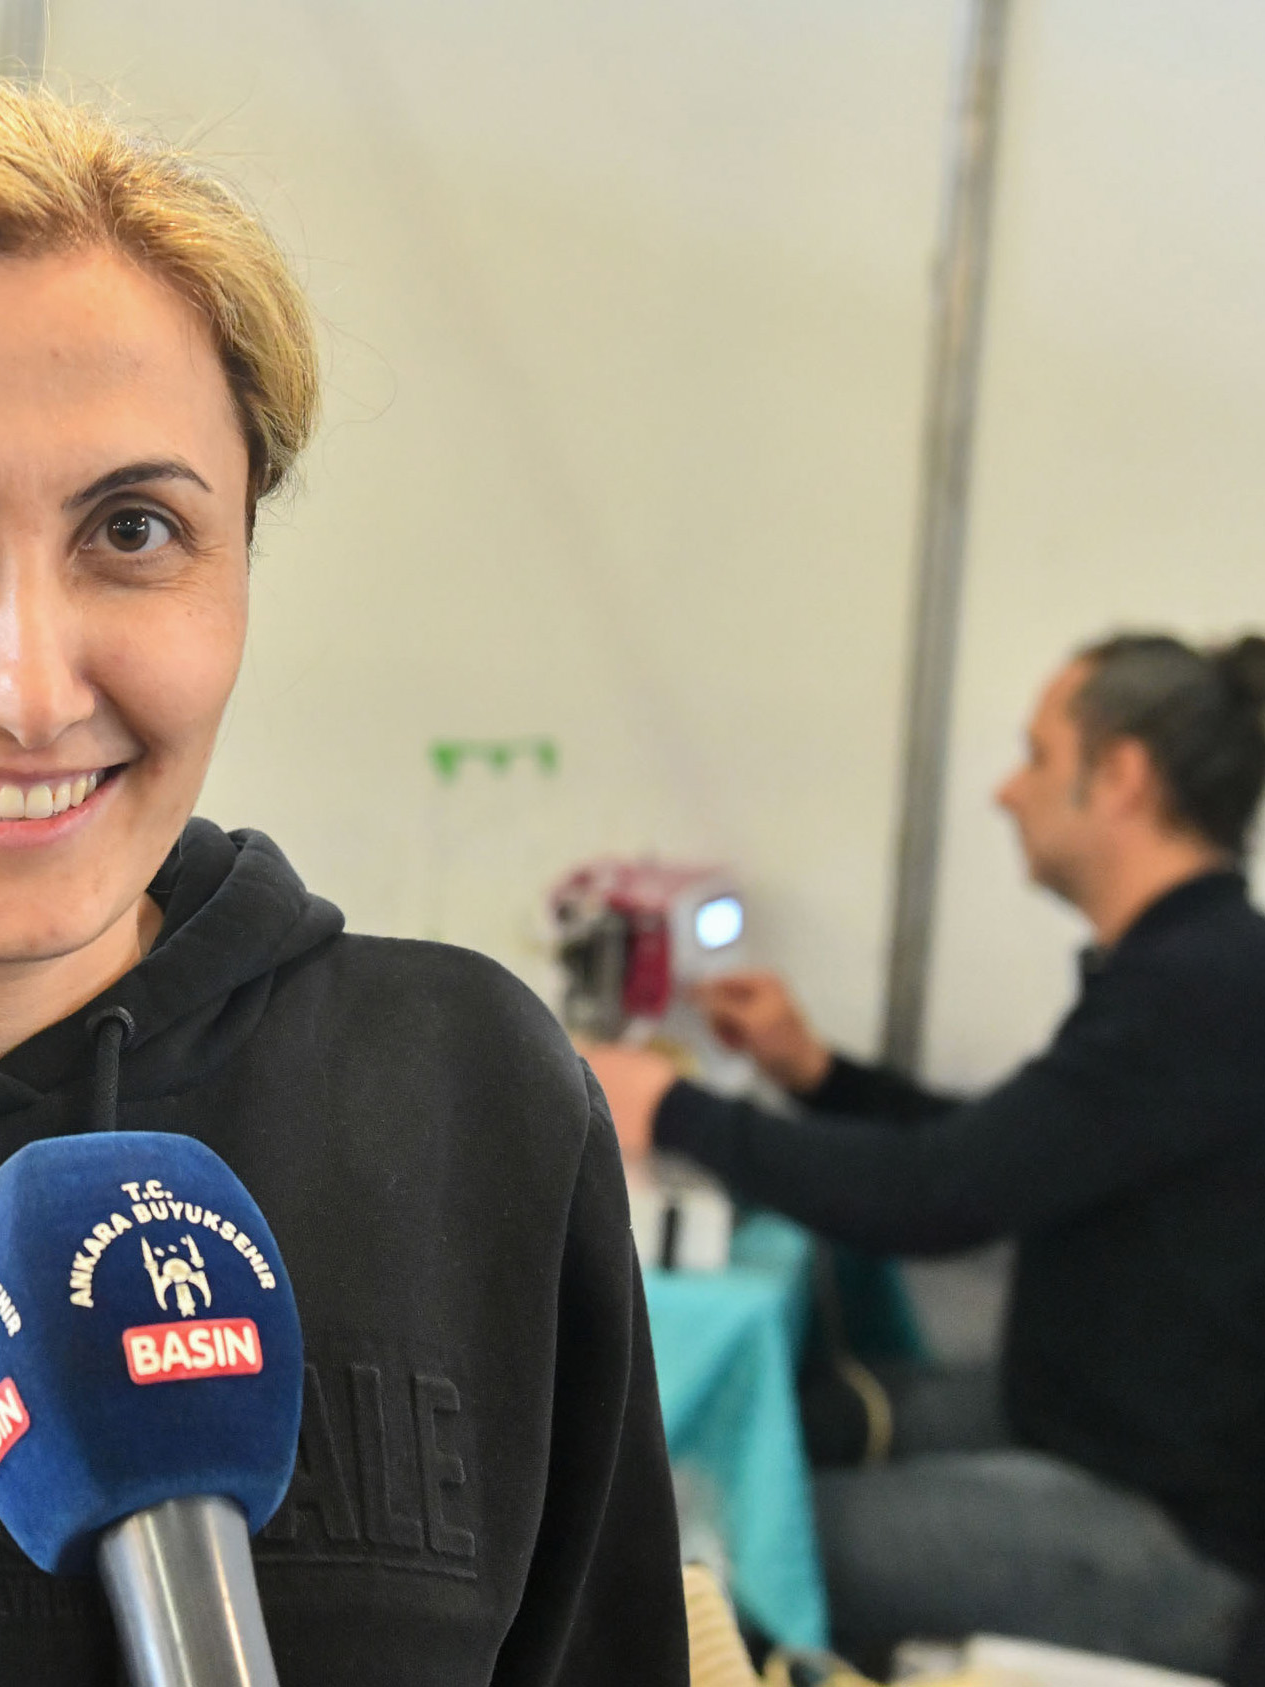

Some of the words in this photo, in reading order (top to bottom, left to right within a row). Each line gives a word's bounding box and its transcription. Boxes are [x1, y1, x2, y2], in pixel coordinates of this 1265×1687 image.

[121, 1179, 173, 1202] T.C.
[69, 1212, 133, 1309] ANKARA
[131, 1327, 256, 1375] BASIN
